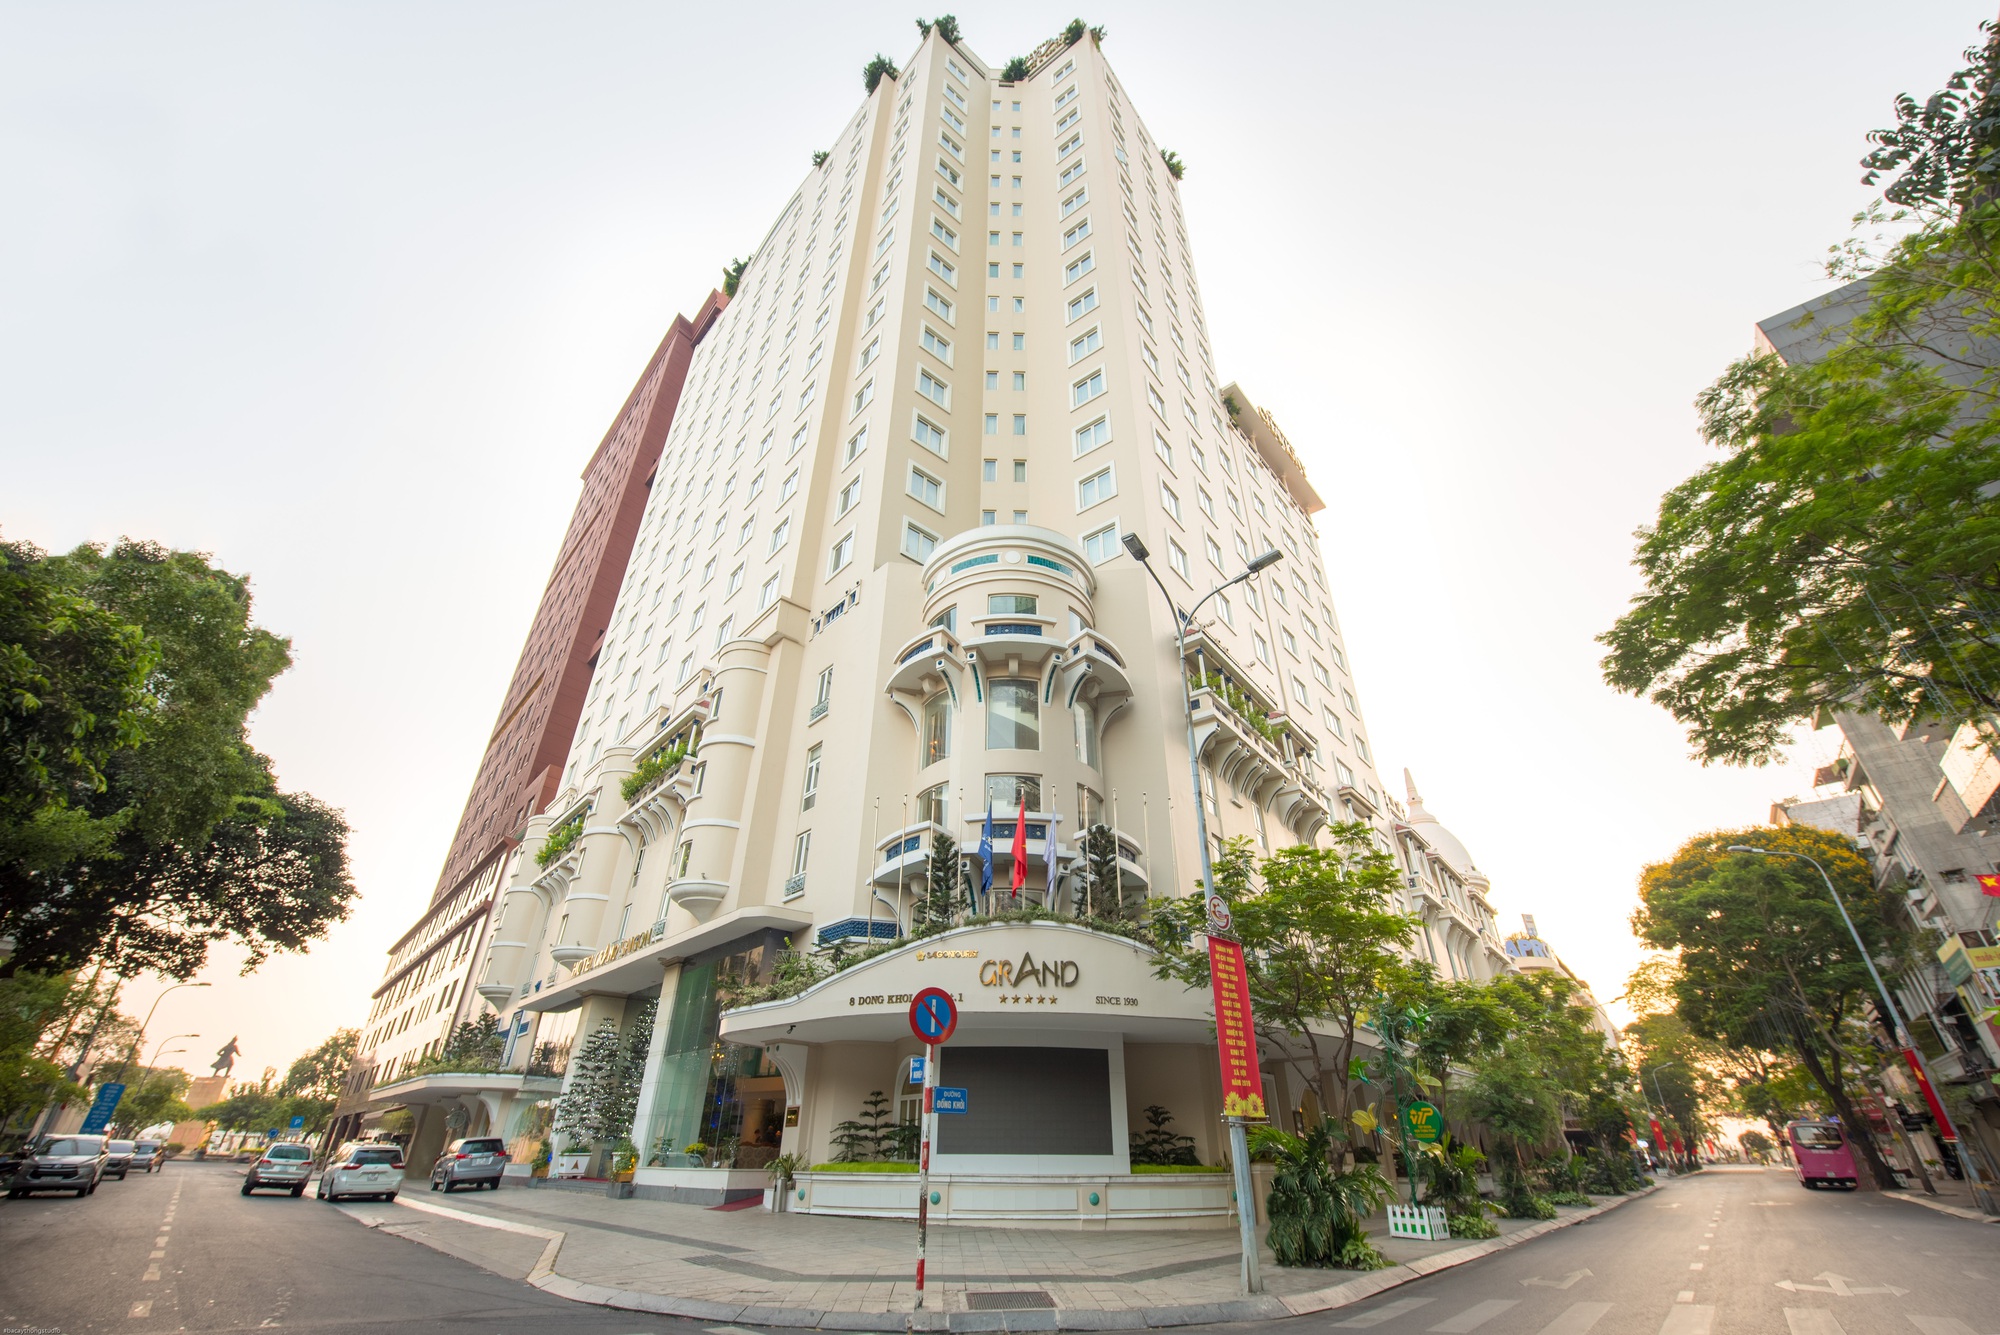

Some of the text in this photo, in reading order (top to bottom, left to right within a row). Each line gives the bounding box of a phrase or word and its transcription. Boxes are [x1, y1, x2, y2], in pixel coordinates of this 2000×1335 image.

[979, 952, 1079, 988] GRAND
[849, 996, 856, 1006] 8
[858, 996, 884, 1006] DONG
[887, 994, 914, 1004] KHOI
[1096, 996, 1138, 1006] SINCE 1930
